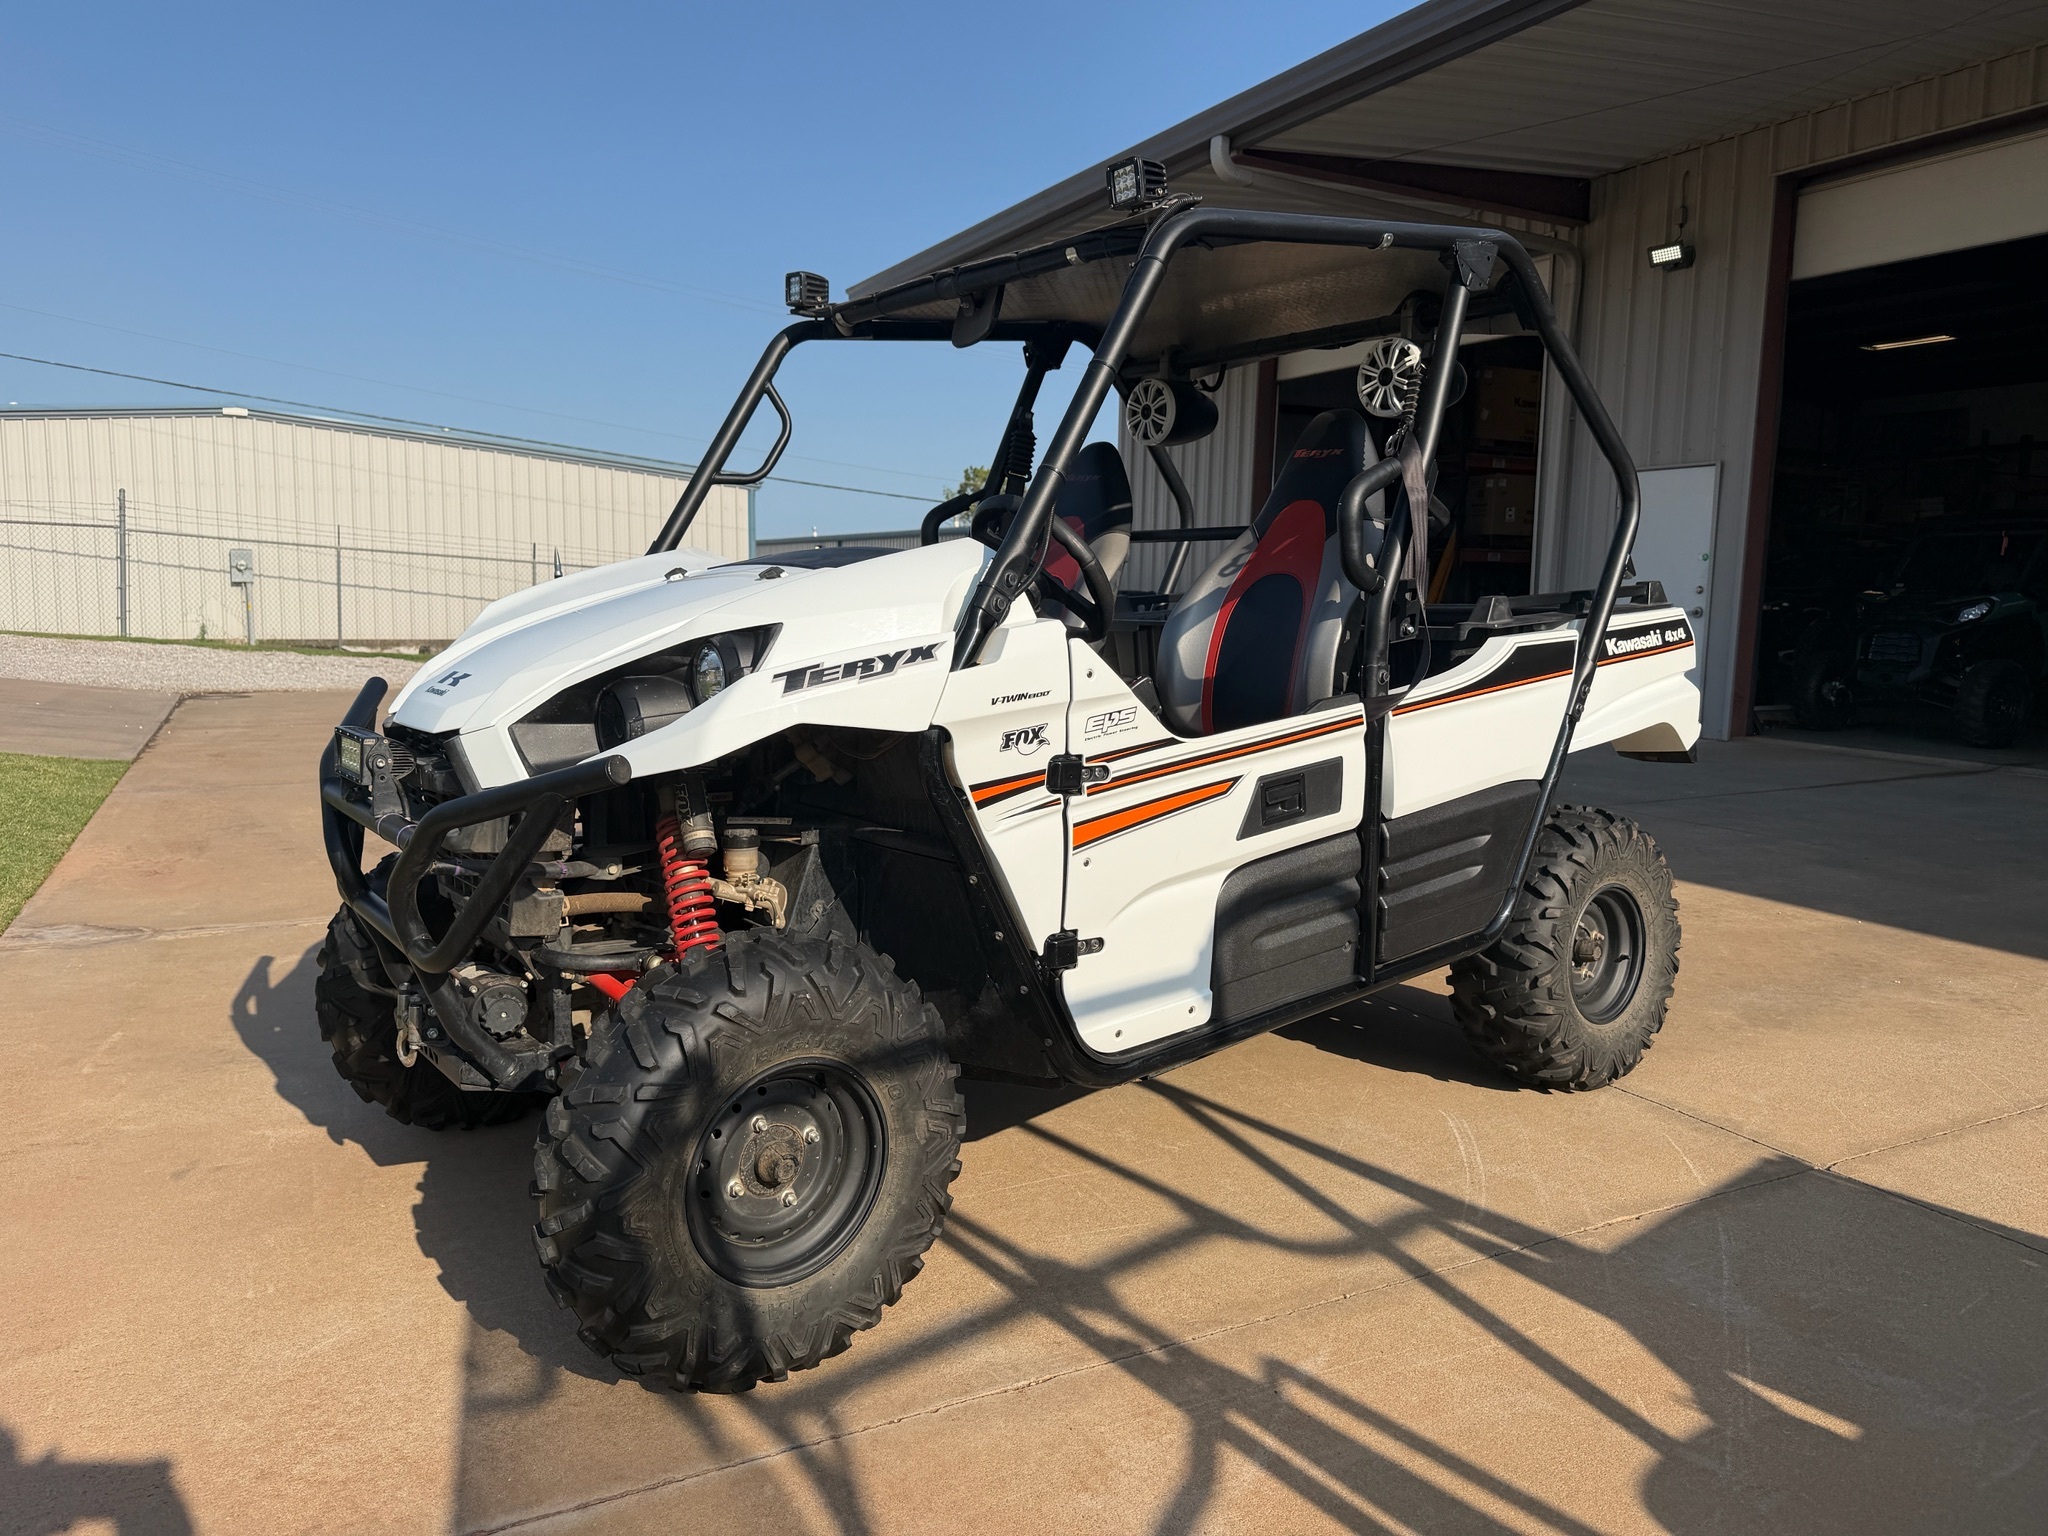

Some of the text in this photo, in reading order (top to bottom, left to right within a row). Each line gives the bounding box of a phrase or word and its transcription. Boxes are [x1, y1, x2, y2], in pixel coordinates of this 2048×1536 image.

[1605, 627, 1687, 656] Kawasaki 4x4
[1085, 706, 1138, 734] EPS
[1001, 724, 1046, 750] FOX
[674, 783, 694, 827] FOX
